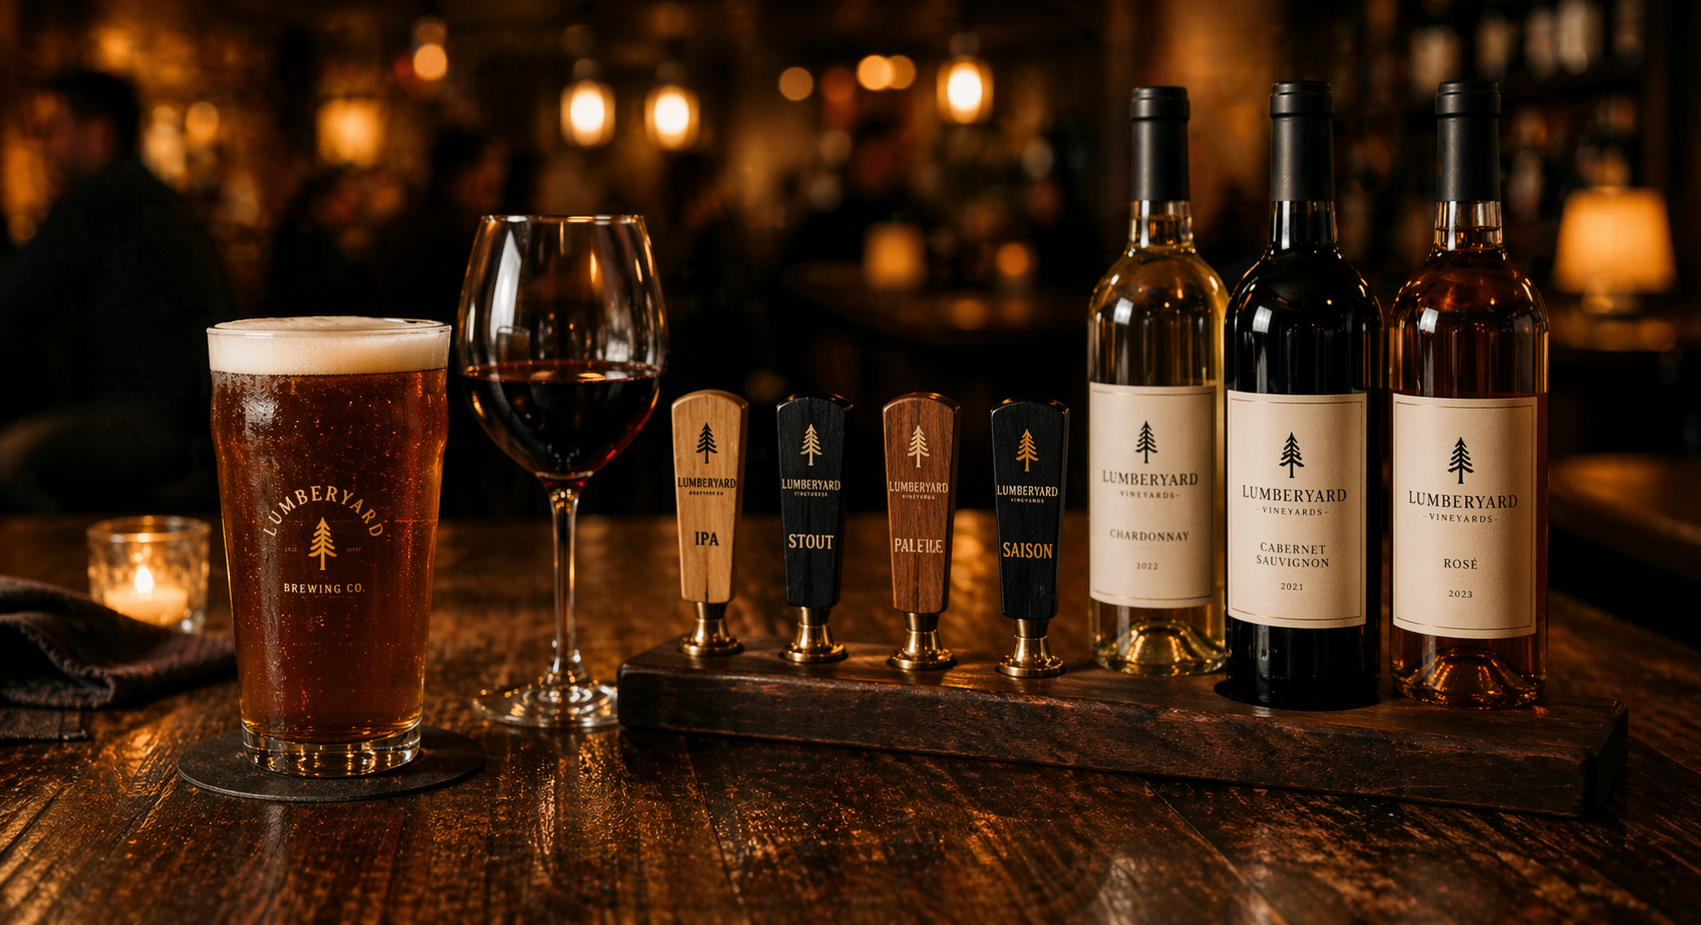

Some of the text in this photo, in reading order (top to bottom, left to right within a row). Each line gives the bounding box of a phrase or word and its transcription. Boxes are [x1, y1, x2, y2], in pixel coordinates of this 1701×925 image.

[677, 477, 737, 489] LUMBERYARD
[781, 478, 841, 491] LUMBERYARD
[1102, 469, 1199, 486] LUMBERYARD
[889, 481, 949, 494] LUMBERYARD
[997, 484, 1059, 497] LUMBERYARD
[1242, 484, 1347, 503] LUMBERYARD
[1408, 490, 1518, 509] LUMBERYARD
[263, 485, 383, 537] LUMBERYARD
[695, 531, 719, 546] IPA
[788, 533, 835, 550] STOUT
[1109, 528, 1190, 542] CHARDONNAY
[1002, 541, 1053, 559] SAISON
[1260, 541, 1326, 555] CABERNET
[1136, 562, 1158, 570] 2022
[1256, 554, 1330, 568] SAUVIGNON
[1443, 557, 1478, 570] ROSÉ
[283, 583, 365, 594] BREWING CO.
[1280, 582, 1303, 591] 2021
[1448, 589, 1473, 599] 2023
